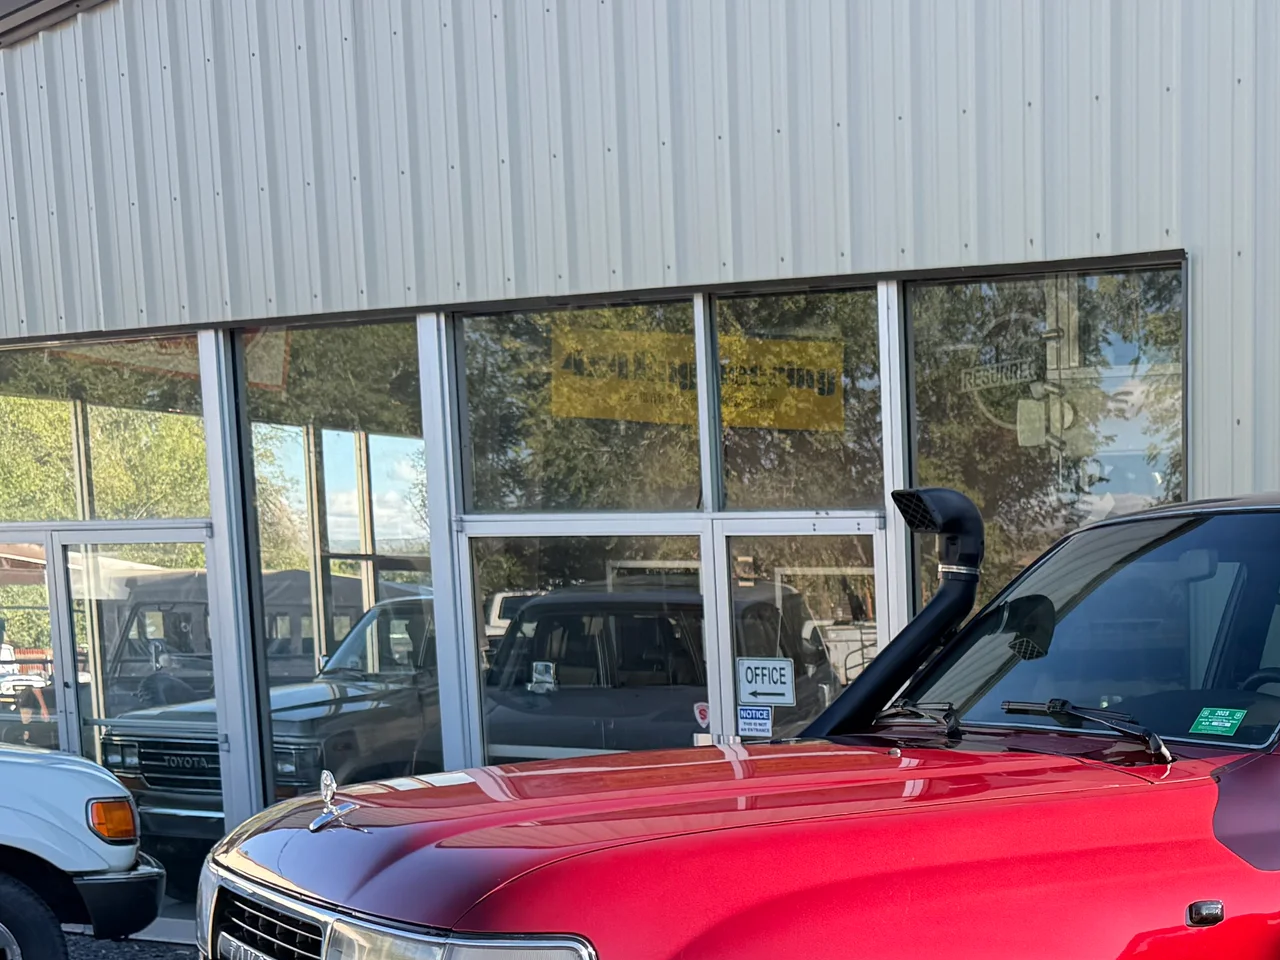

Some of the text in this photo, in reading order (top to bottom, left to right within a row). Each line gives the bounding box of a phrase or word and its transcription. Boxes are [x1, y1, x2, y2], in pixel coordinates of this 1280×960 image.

[745, 666, 786, 684] OFFICE
[740, 710, 769, 719] NOTICE
[163, 755, 208, 769] TOYOTA
